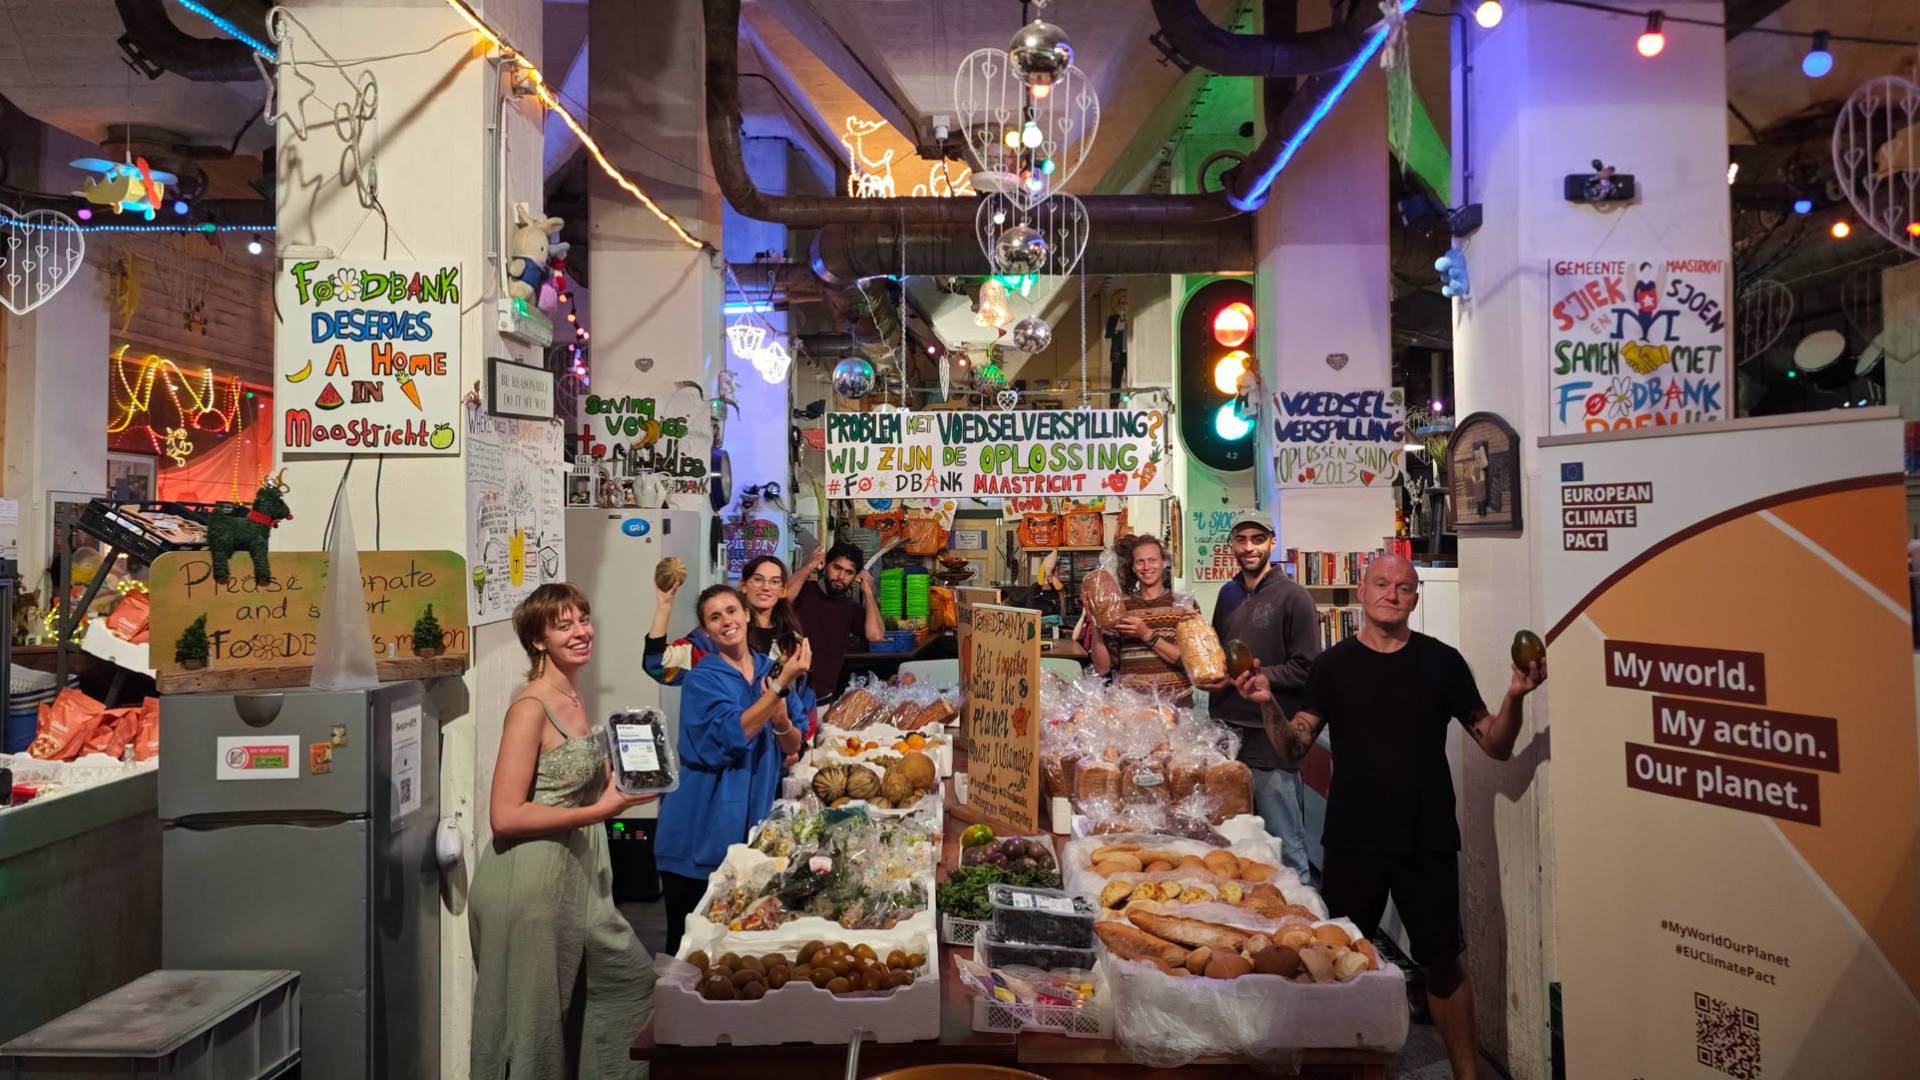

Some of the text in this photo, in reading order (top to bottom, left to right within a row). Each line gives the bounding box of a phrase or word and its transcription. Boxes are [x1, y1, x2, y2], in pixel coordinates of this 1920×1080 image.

[1555, 261, 1625, 276] GEMEENTE
[1666, 260, 1722, 274] MAASTRICHT
[1553, 277, 1626, 331] SJIEK
[1666, 279, 1725, 333] SJOEN
[311, 309, 433, 343] DESERVES
[1591, 314, 1612, 335] EN
[325, 345, 349, 376] A
[1554, 340, 1722, 375] SAMEN MET
[351, 381, 384, 404] IN
[585, 395, 656, 417] Saving
[826, 410, 1163, 447] PROBLEM MET VOEDSELVERSPILLING?
[1274, 419, 1404, 443] VERSPILLING
[827, 443, 1138, 475] WIJ ZIJN DE OPLOSSING
[1314, 462, 1357, 485] 2013
[1354, 446, 1395, 480] SINDS
[973, 473, 1087, 495] MAASTRICHT
[1564, 485, 1651, 503] EUROPEAN
[1565, 509, 1635, 526] CLIMATE
[1565, 533, 1605, 549] PACT
[321, 560, 436, 592] nate
[1195, 567, 1238, 581] VERKW
[236, 596, 288, 621] and
[1613, 651, 1756, 692] My world.
[1661, 708, 1827, 760] My action.
[1634, 753, 1808, 812] Our planet.
[1661, 919, 1790, 968] #MyWorldOurPlanet
[1675, 944, 1776, 985] #EUClimatePact
